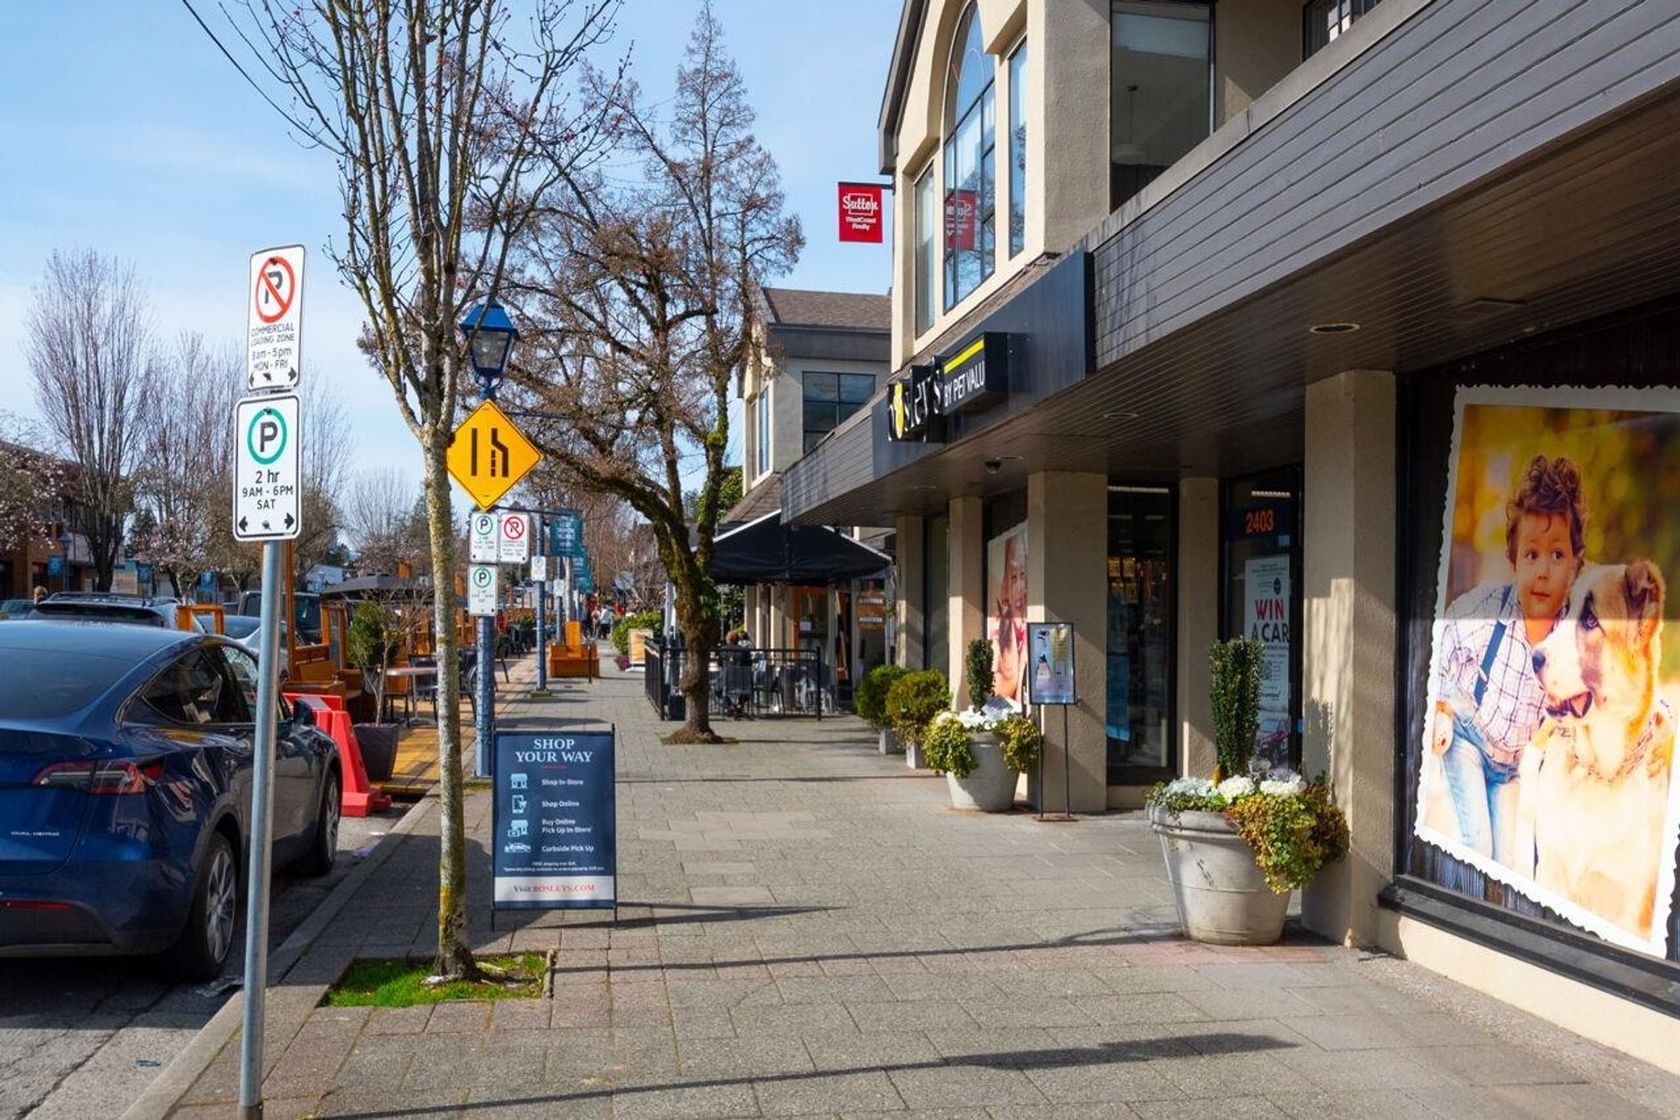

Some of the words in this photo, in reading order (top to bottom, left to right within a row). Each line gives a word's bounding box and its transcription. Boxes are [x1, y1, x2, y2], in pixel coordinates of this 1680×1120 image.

[843, 195, 879, 210] Sutton
[251, 322, 295, 337] COMMERCIAL
[251, 335, 274, 347] LOADING
[276, 333, 295, 343] ZONE
[253, 361, 269, 371] MON
[274, 359, 288, 369] FRI
[953, 373, 966, 403] PET
[965, 360, 986, 393] VALU
[255, 470, 263, 484] 2
[266, 468, 281, 484] hr
[242, 486, 263, 498] 9AM
[273, 485, 294, 496] 6PM
[256, 499, 276, 510] SAT
[1245, 509, 1275, 534] 2403
[1254, 598, 1284, 621] WIN
[1251, 622, 1260, 642] A
[1261, 622, 1290, 643] CAR
[533, 738, 575, 750] SHOP
[515, 751, 557, 763] YOUR
[561, 751, 593, 763] WAY
[541, 778, 558, 787] Shop
[541, 800, 558, 808] Shop
[542, 818, 554, 826] Buy
[555, 818, 576, 826] Online
[585, 845, 595, 853] Up
